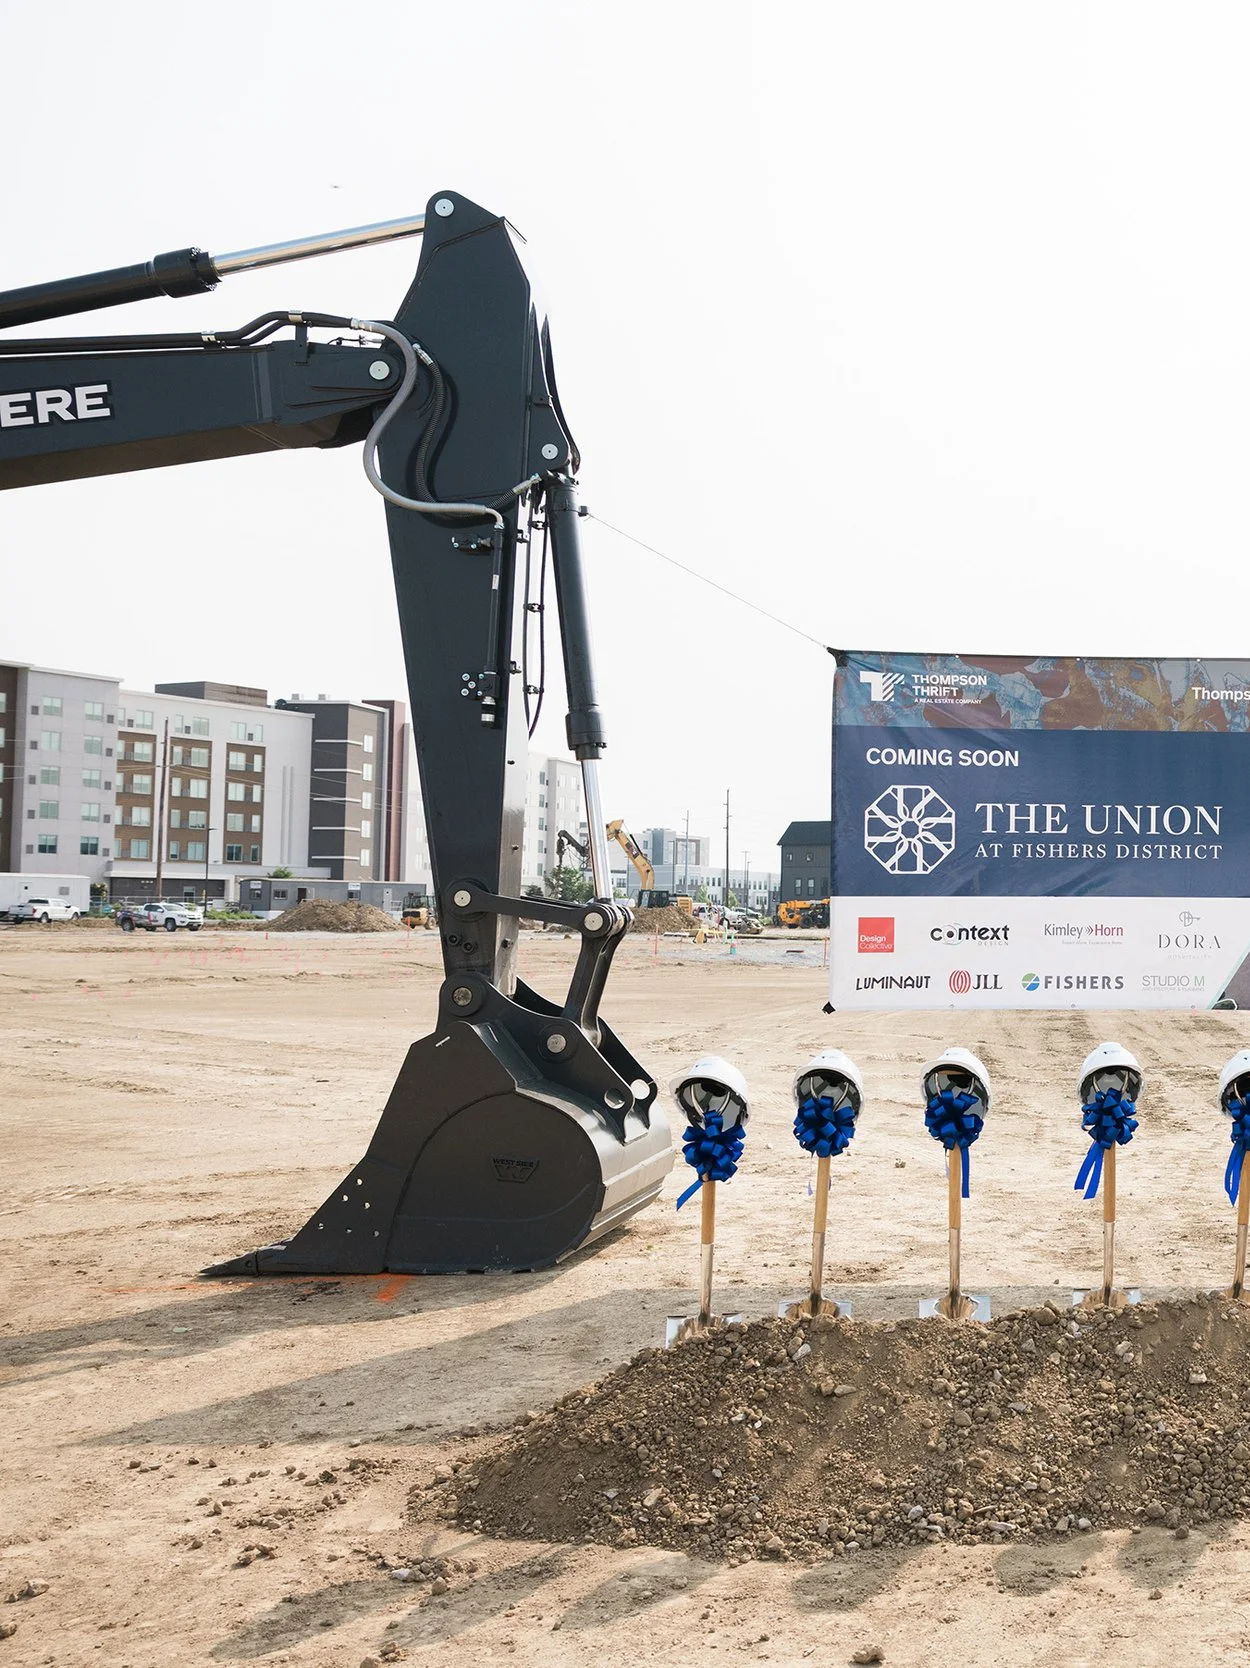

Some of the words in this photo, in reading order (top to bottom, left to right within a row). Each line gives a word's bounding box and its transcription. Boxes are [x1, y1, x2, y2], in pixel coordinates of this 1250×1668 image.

[911, 674, 987, 686] THOMPSON
[911, 685, 959, 697] THRIFT
[865, 747, 953, 767] COMING
[958, 749, 1020, 767] SOON
[974, 803, 1069, 835] THE
[1081, 804, 1224, 836] UNION
[974, 843, 1003, 859] AT
[1011, 843, 1108, 860] FISHERS
[1115, 844, 1223, 861] DISTRICT
[1095, 924, 1124, 937] Horn
[860, 934, 887, 943] Design
[1158, 934, 1221, 949] DORA
[859, 942, 893, 951] Collective
[856, 975, 931, 991] LUMINAUT
[972, 974, 1004, 990] JLL
[1044, 975, 1125, 990] FISHERS
[1142, 975, 1190, 987] STUDIO
[1194, 975, 1205, 987] M
